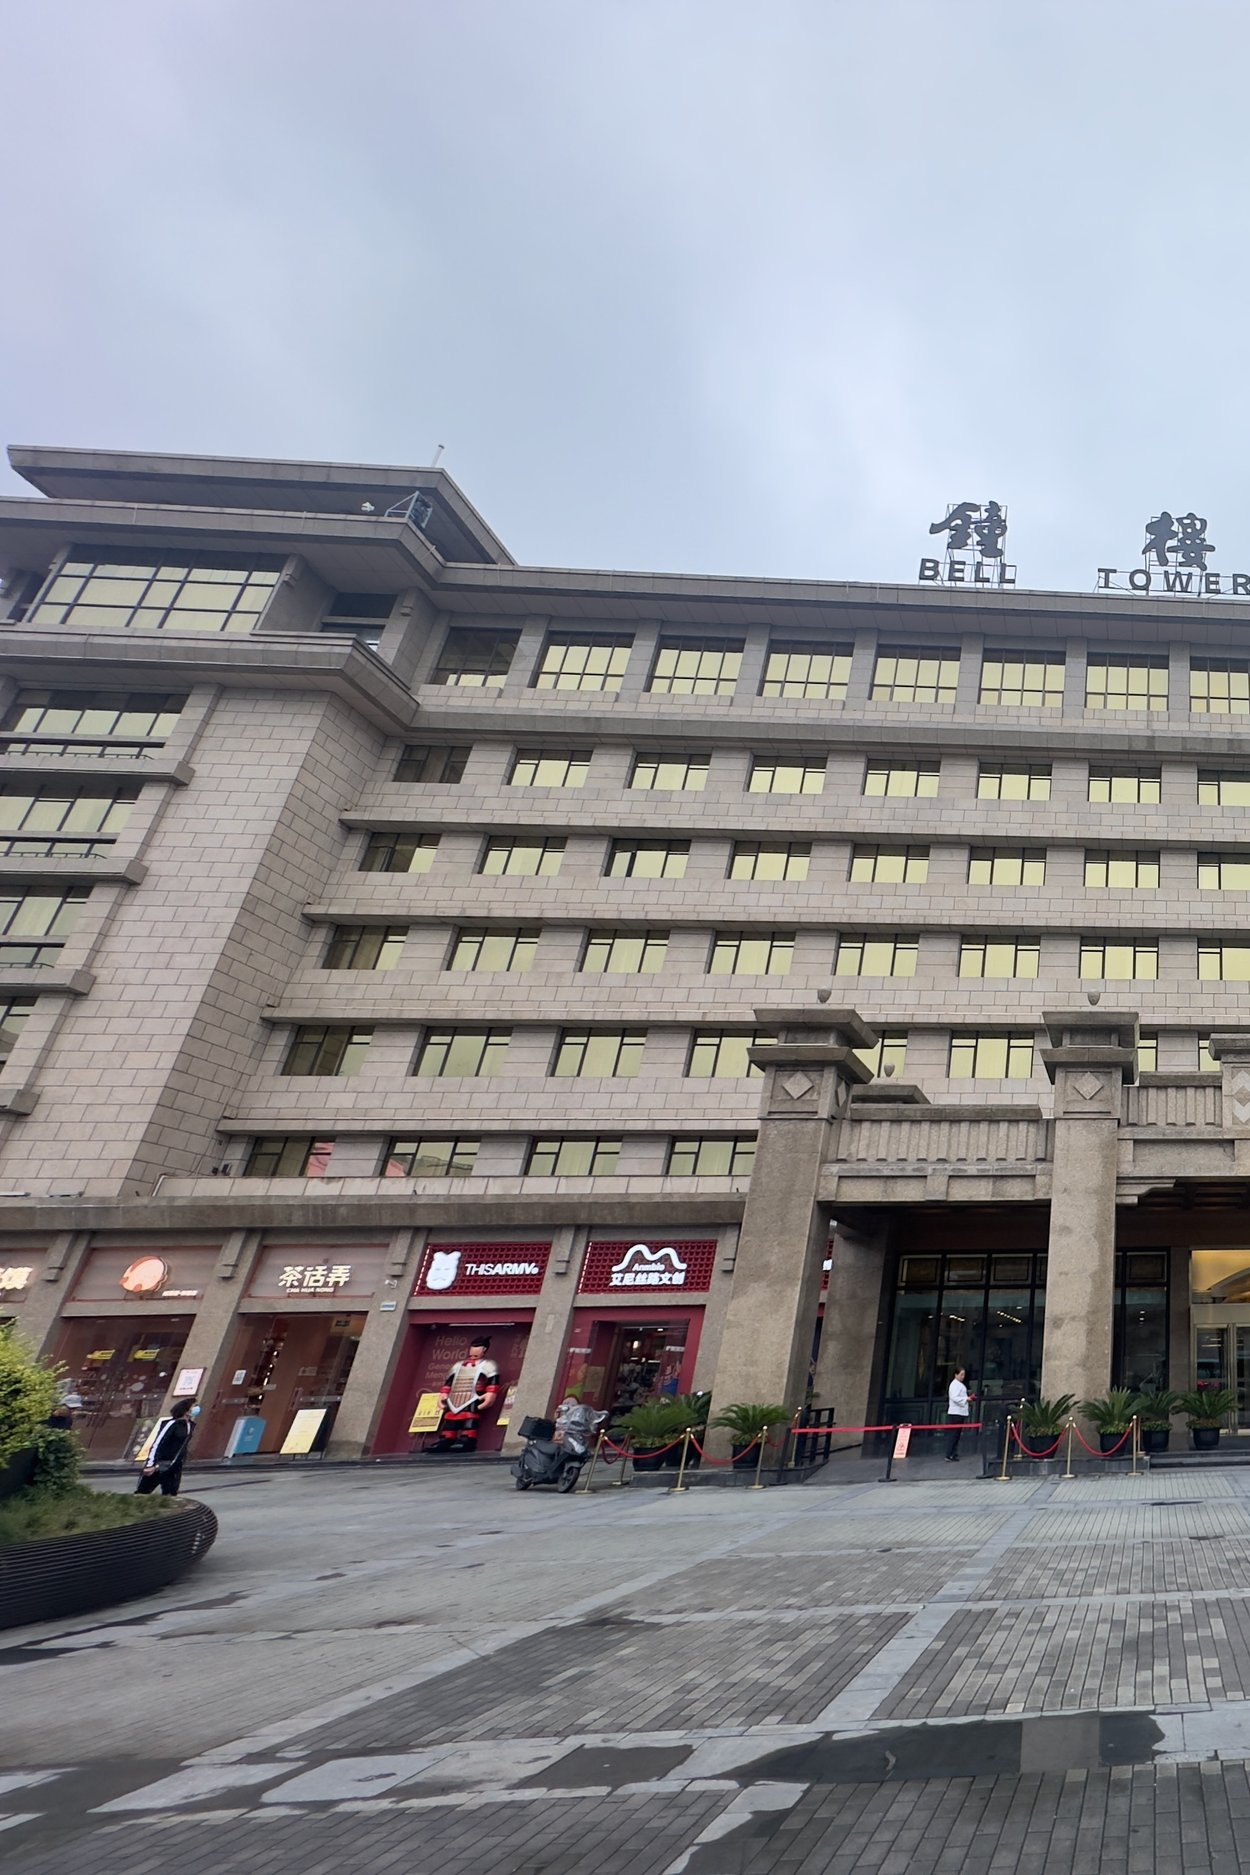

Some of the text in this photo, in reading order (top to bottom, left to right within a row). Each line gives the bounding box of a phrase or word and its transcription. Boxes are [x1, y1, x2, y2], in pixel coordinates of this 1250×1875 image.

[919, 558, 1016, 584] BELL
[1098, 568, 1250, 595] TOWER
[278, 1265, 351, 1287] 茶话弄
[434, 1335, 467, 1346] Hello
[432, 1349, 470, 1360] World
